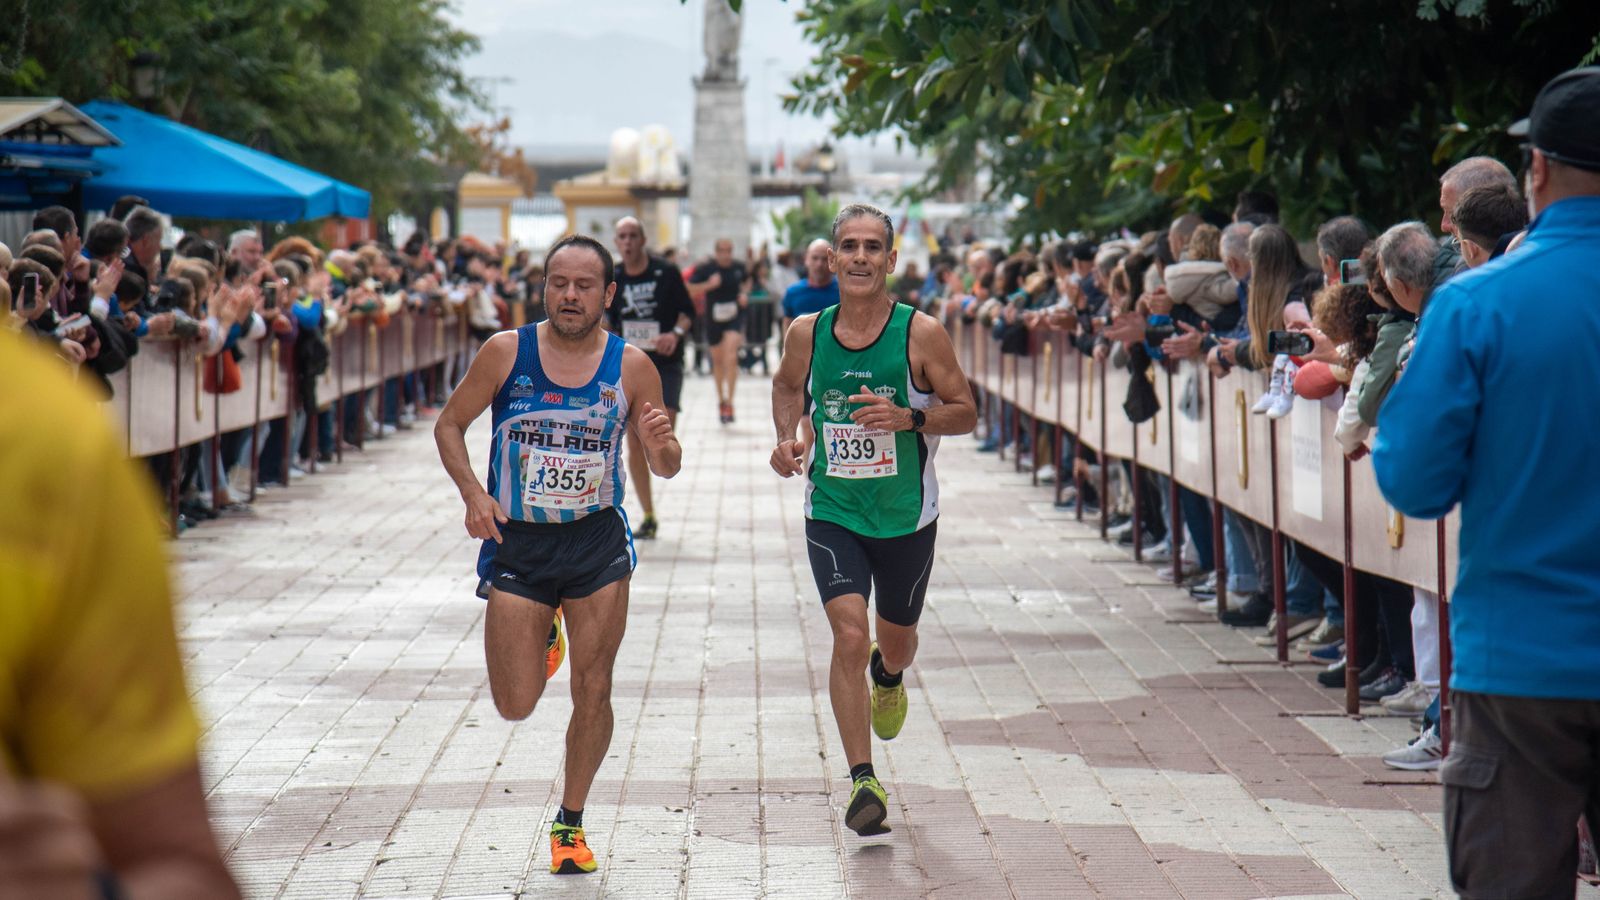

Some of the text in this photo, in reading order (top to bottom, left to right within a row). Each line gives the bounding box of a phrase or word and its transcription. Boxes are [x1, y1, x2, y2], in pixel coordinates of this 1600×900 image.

[520, 419, 602, 435] ATLETISMO
[832, 428, 853, 439] XIV
[508, 429, 612, 453] MÁLAGA
[839, 438, 875, 460] 339
[542, 455, 568, 469] XIV
[546, 468, 587, 491] 355
